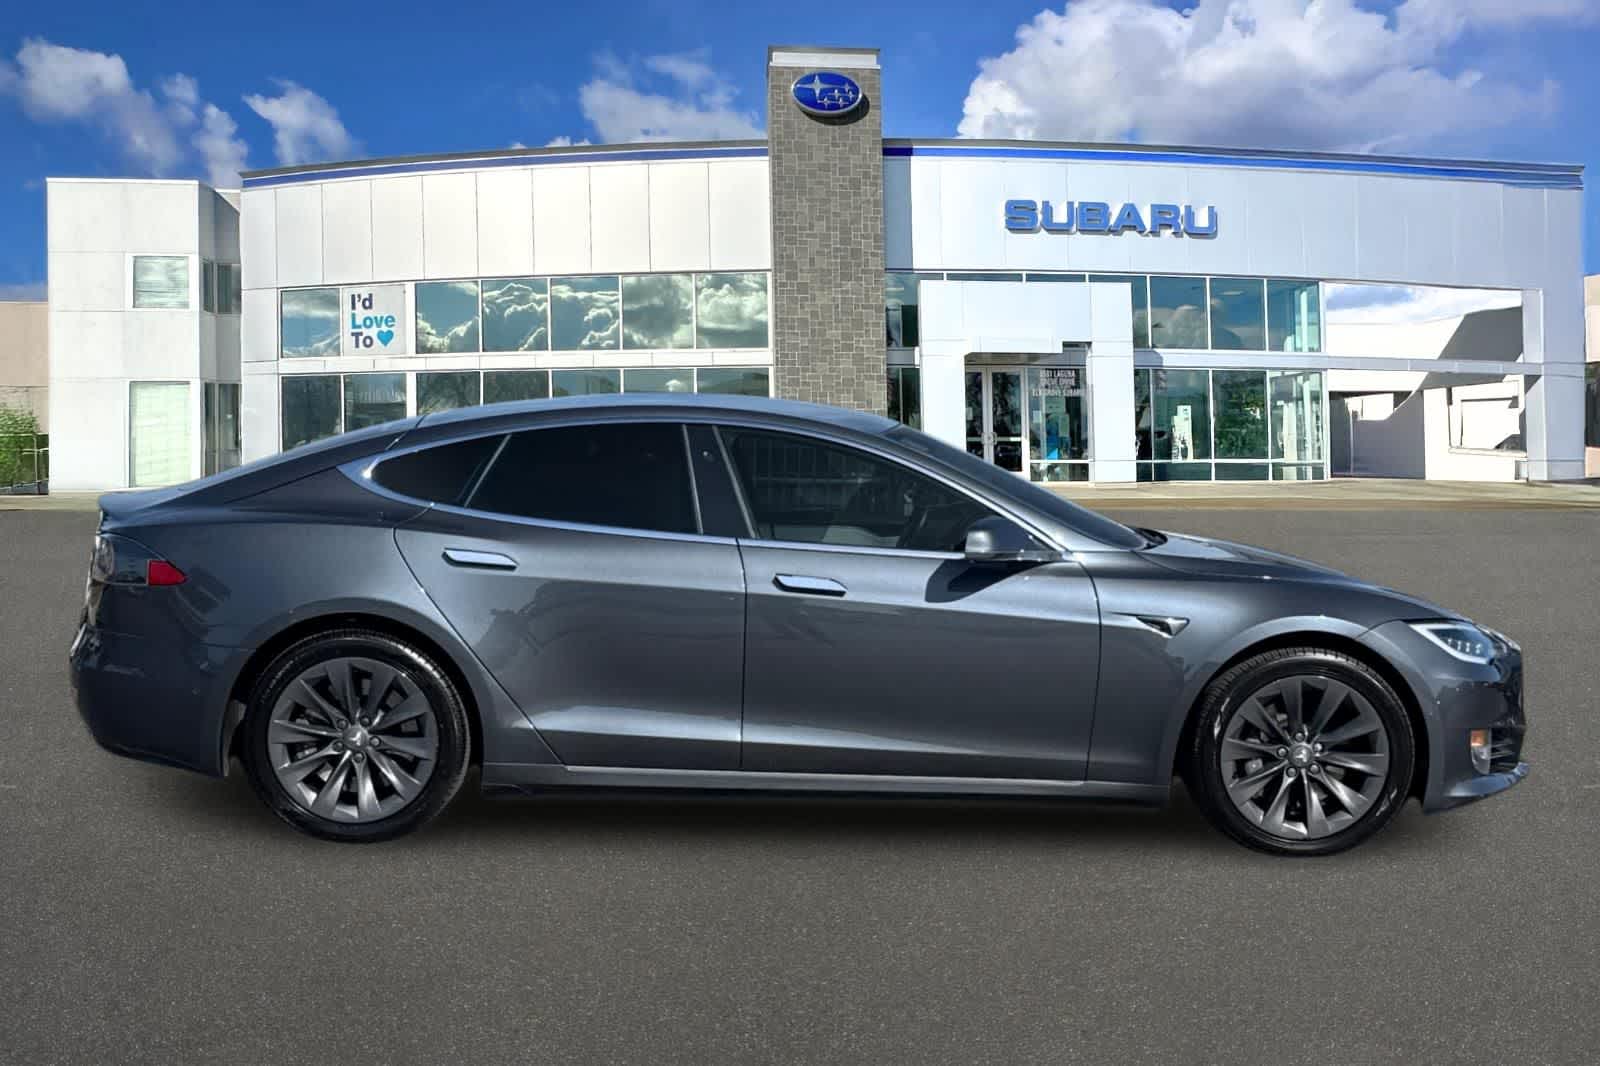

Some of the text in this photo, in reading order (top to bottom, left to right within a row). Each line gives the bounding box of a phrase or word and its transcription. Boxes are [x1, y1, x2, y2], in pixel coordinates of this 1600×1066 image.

[1005, 199, 1218, 237] SUBARU
[351, 293, 373, 310] I'd
[351, 313, 396, 329] Love
[351, 332, 374, 349] To
